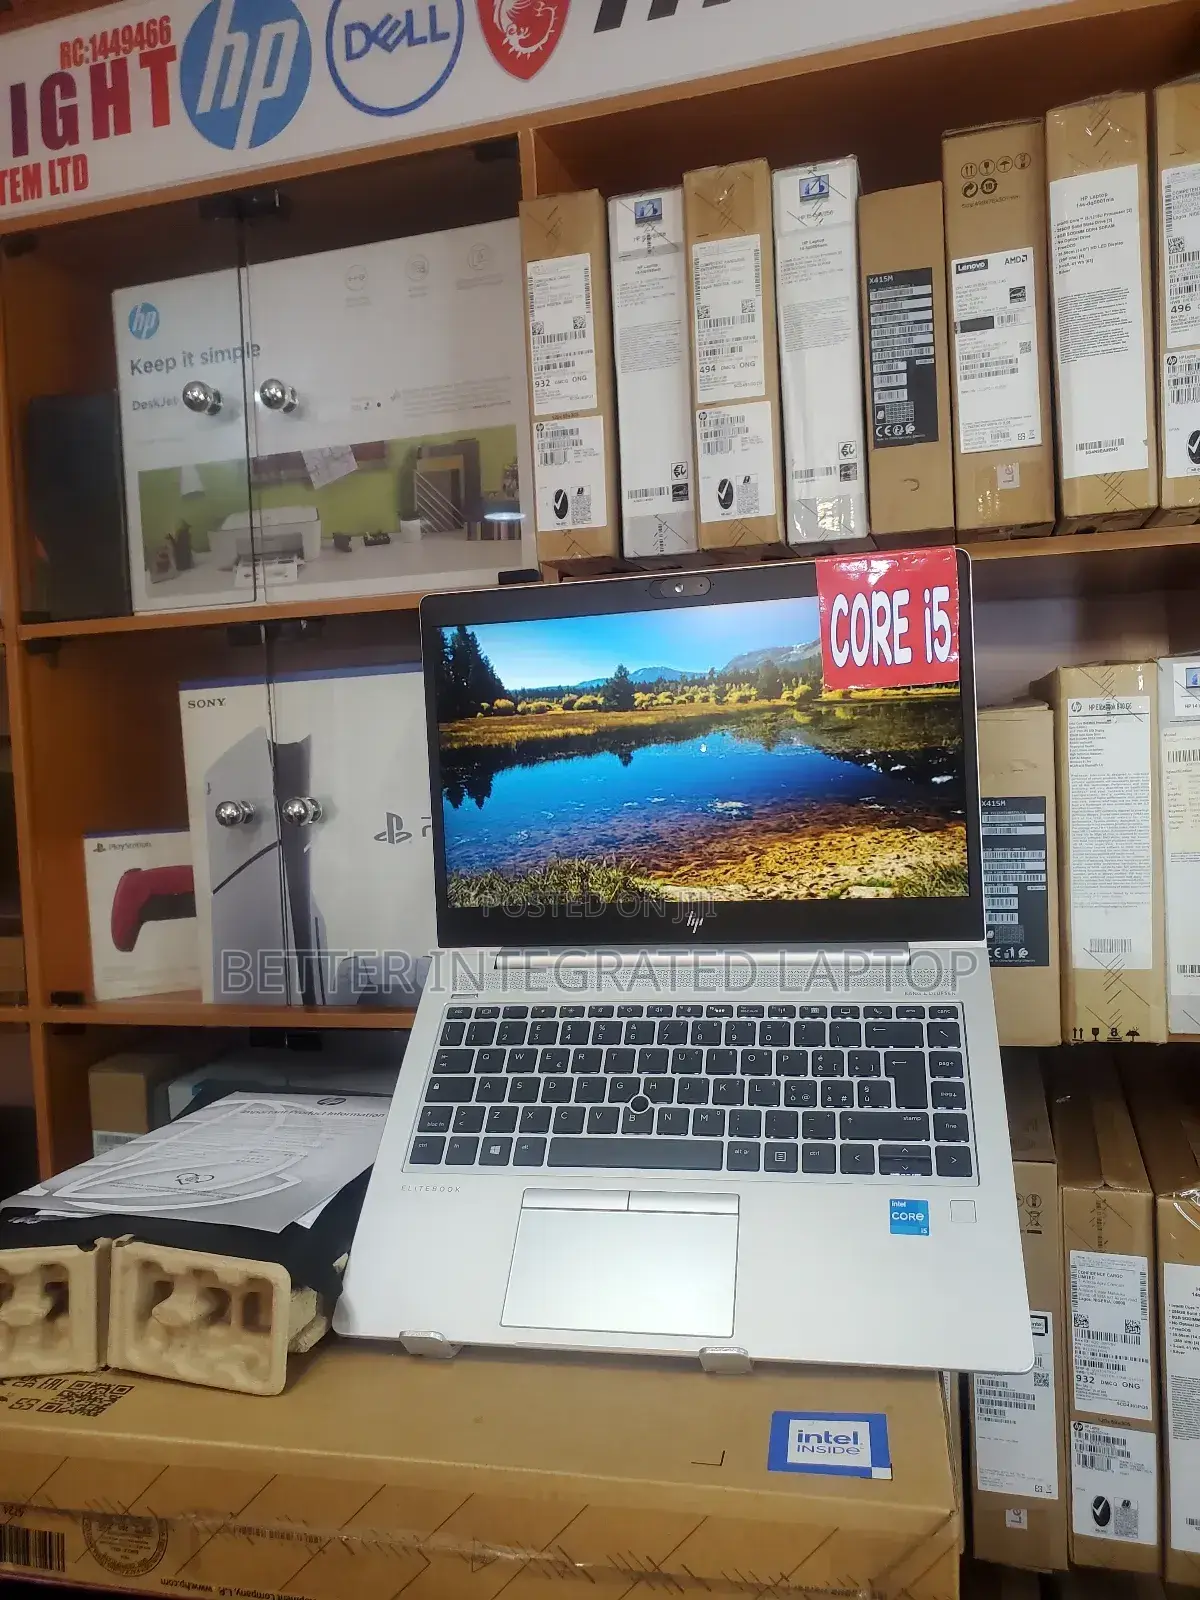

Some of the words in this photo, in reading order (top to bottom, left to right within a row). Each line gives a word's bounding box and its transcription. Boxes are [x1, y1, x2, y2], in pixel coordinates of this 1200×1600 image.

[344, 4, 450, 62] DELL
[59, 15, 172, 69] RC:1449466
[48, 154, 89, 197] LTD
[1004, 256, 1021, 265] AMD
[957, 261, 986, 272] Lenovo
[869, 274, 894, 284] X415M
[1170, 303, 1192, 314] 496
[128, 302, 160, 340] hp
[130, 356, 177, 376] Keep
[182, 349, 195, 368] it
[200, 341, 261, 367] simple
[699, 364, 716, 374] 494
[534, 378, 551, 388] 932
[572, 374, 588, 383] ONG
[830, 588, 914, 669] CORE
[923, 585, 952, 664] i5
[187, 697, 227, 709] SONY
[678, 1053, 685, 1061] U
[616, 1081, 624, 1089] G
[649, 1082, 657, 1090] H
[755, 1084, 762, 1092] L
[802, 1093, 810, 1101] @
[493, 1111, 501, 1119] Z
[526, 1111, 534, 1119] X
[560, 1111, 568, 1119] C
[401, 1185, 461, 1193] ELITEBOOK
[891, 1200, 906, 1208] intel
[1075, 1374, 1095, 1385] 932
[1121, 1381, 1141, 1390] ONG
[797, 1429, 860, 1446] intel
[160, 1577, 213, 1594] www.hp.com
